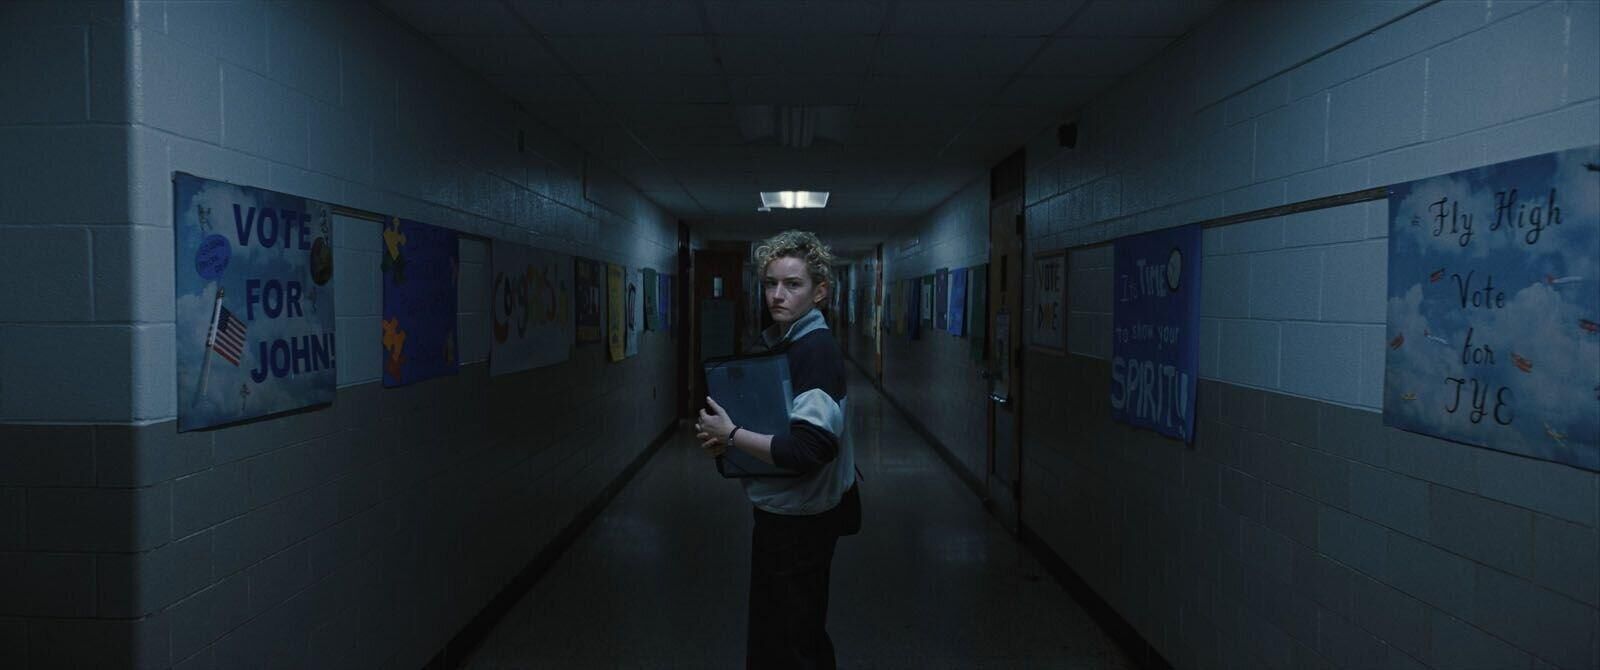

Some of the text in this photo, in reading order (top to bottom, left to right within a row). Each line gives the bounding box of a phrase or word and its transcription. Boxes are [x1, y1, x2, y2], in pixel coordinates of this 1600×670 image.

[233, 203, 311, 250] VOTE
[1428, 187, 1562, 247] Fly High
[245, 278, 303, 320] FOR
[1451, 270, 1506, 309] Vote
[250, 332, 336, 383] JOHN!
[1158, 325, 1180, 351] your
[1462, 327, 1496, 365] for
